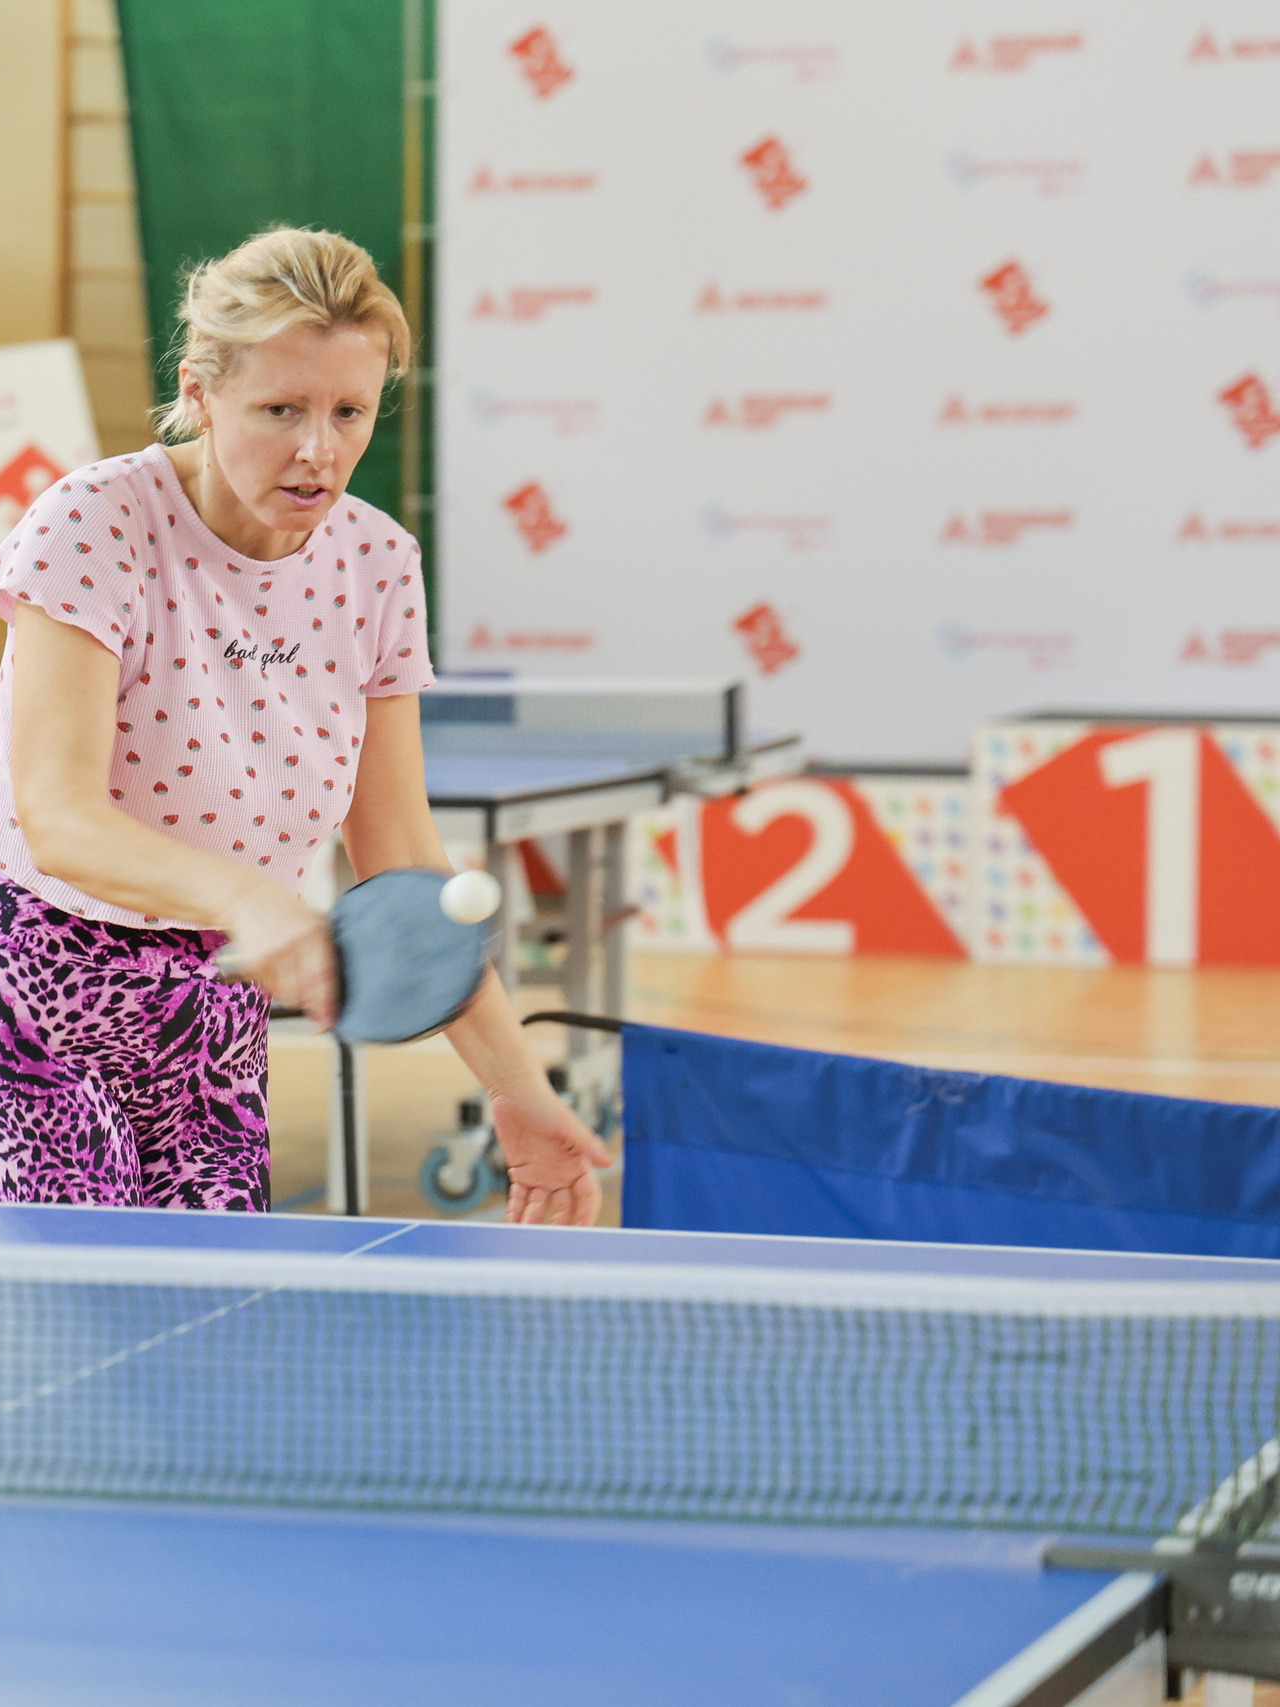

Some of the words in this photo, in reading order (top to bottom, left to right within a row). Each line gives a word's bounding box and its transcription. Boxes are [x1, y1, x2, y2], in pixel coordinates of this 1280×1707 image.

[224, 639, 258, 660] bad
[261, 643, 300, 670] girl
[724, 777, 856, 952] 2
[1097, 730, 1201, 965] 1
